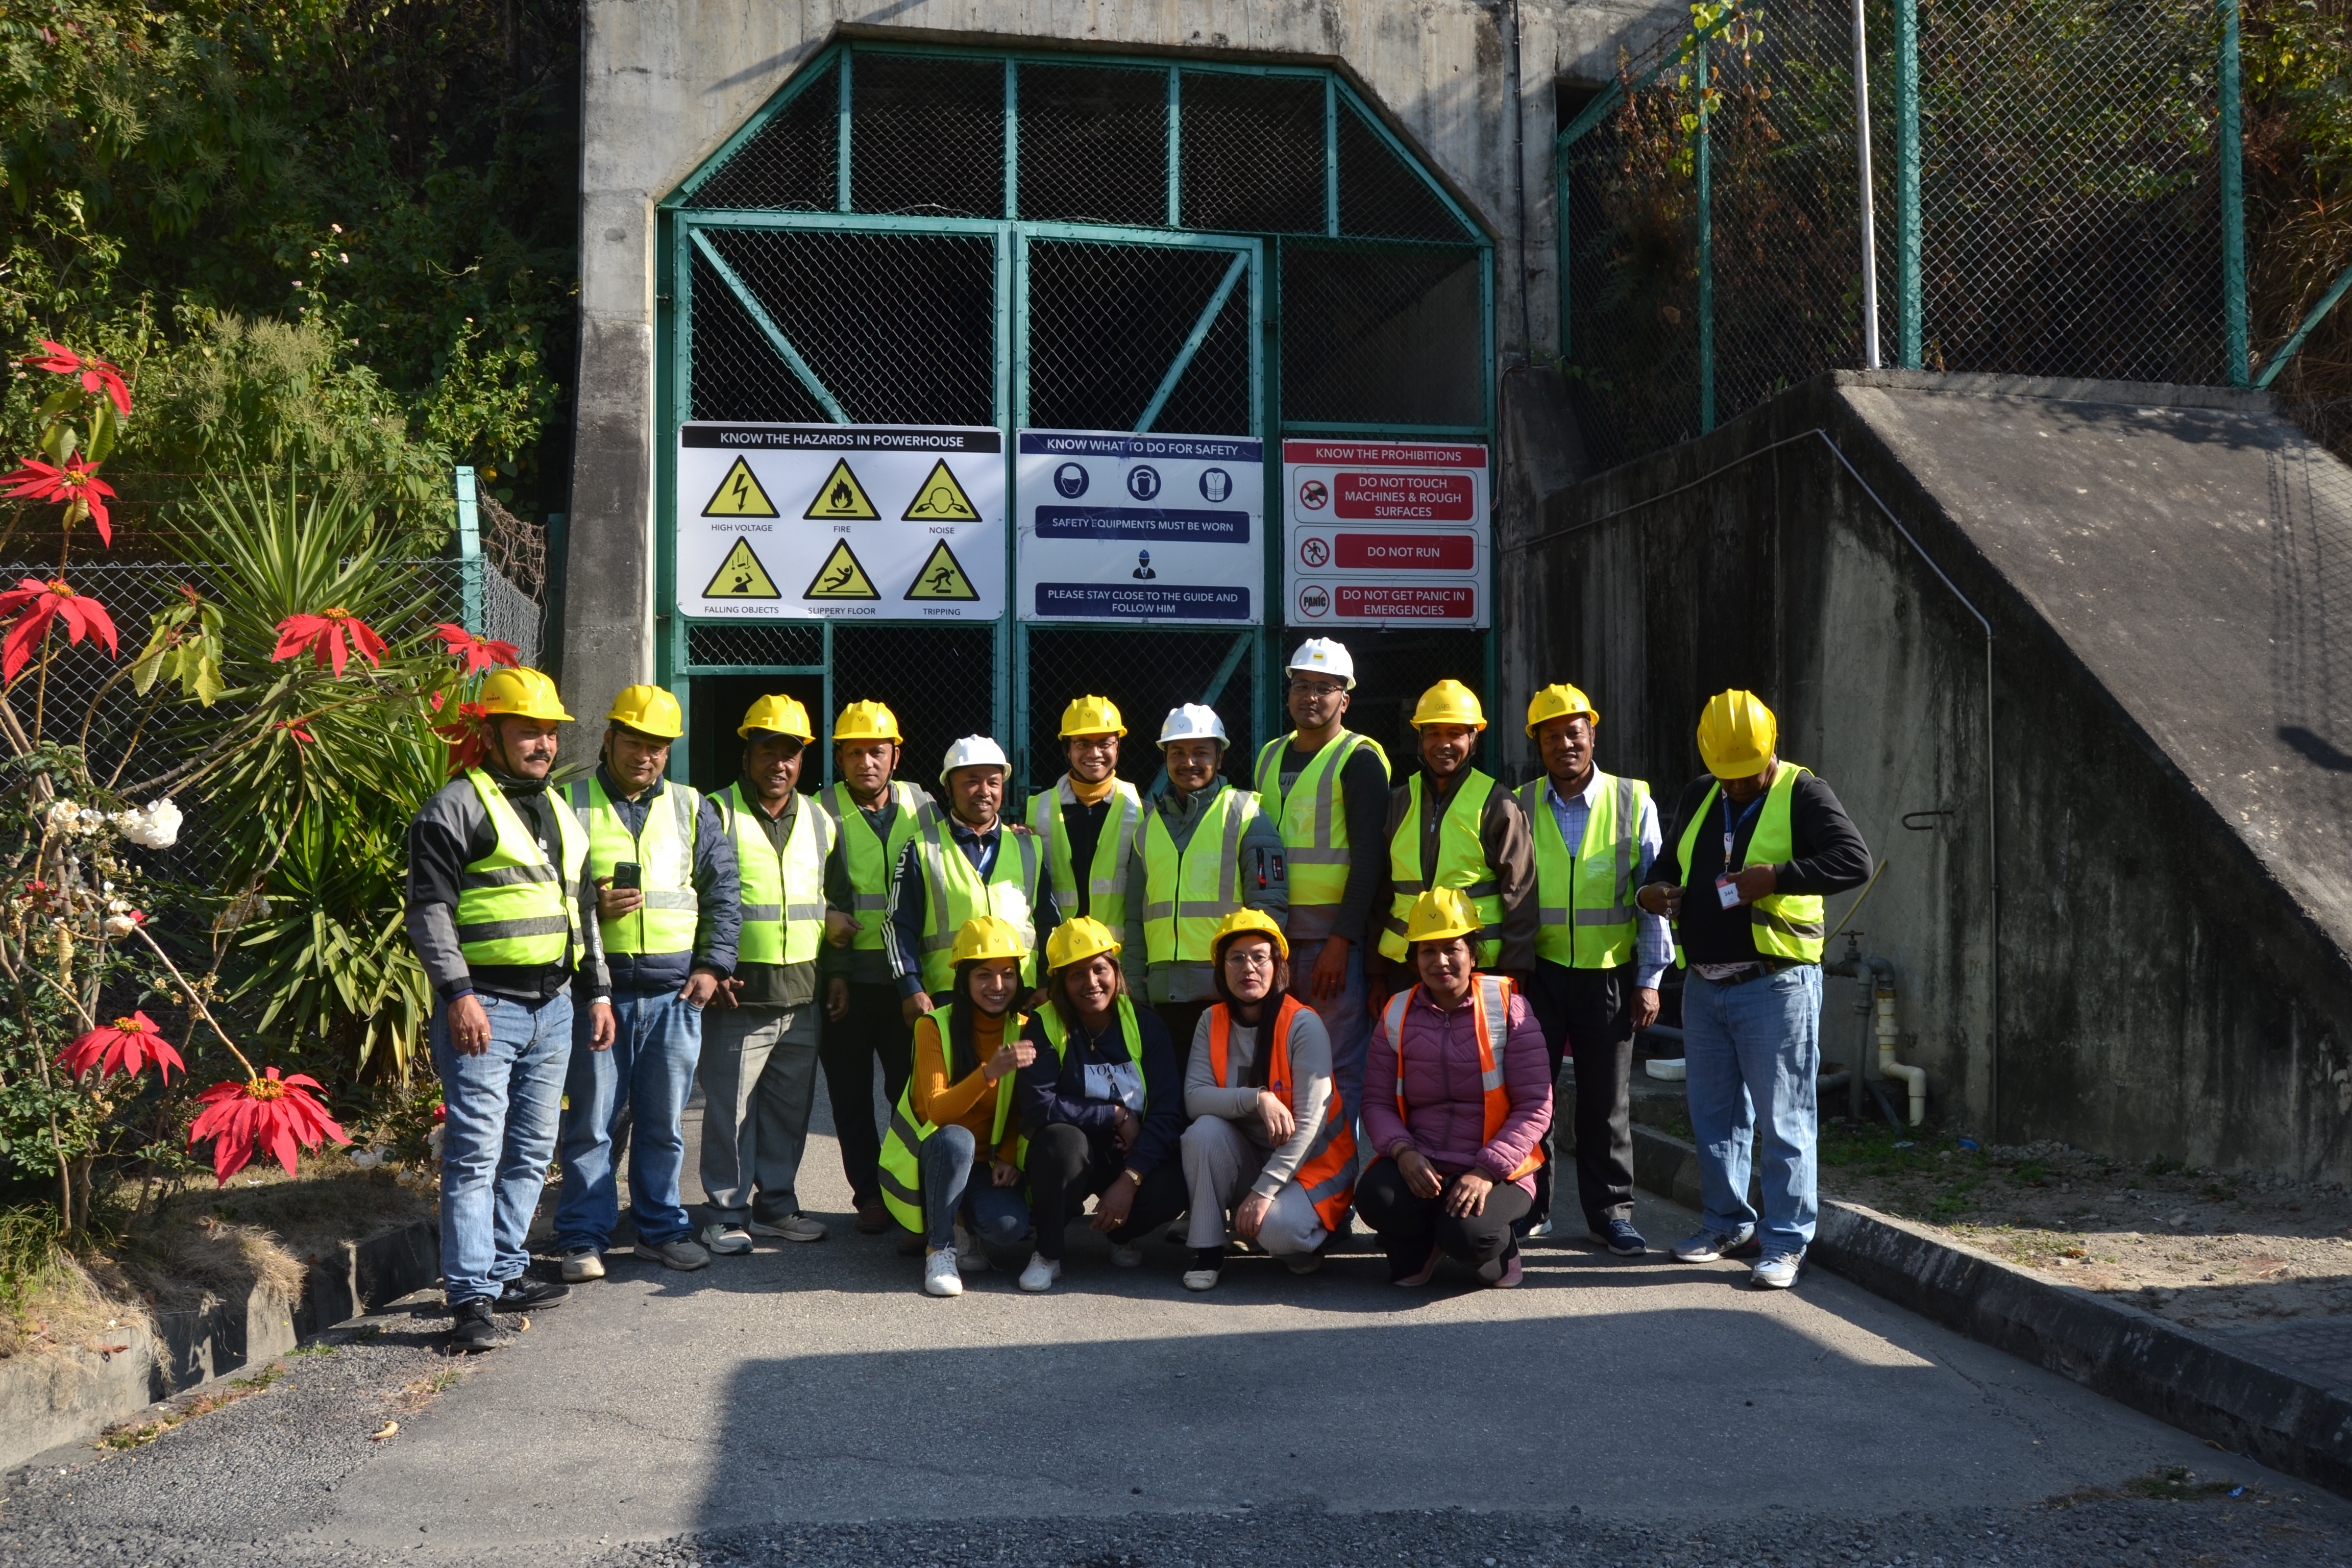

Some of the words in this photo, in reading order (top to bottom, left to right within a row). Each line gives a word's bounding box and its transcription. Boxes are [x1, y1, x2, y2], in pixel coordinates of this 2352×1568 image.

[721, 433, 763, 443] KNOW
[766, 434, 790, 444] THE
[794, 434, 853, 445] HAZARDS
[857, 435, 869, 445] IN
[874, 435, 964, 447] POWERHOUSE
[1048, 439, 1087, 449] KNOW
[1090, 440, 1125, 451] WHAT
[1130, 442, 1143, 451] TO
[1147, 443, 1165, 452] DO
[1169, 444, 1192, 453] FOR
[1196, 445, 1238, 455] SAFETY
[1316, 448, 1354, 458] KNOW
[1357, 449, 1378, 458] THE
[1382, 450, 1461, 461] PROHIBITIONS
[1360, 477, 1377, 486] DO
[1381, 478, 1405, 487] NOT
[1407, 478, 1447, 488] TOUCH
[1345, 492, 1405, 502] MACHINES
[1409, 493, 1416, 502] &
[1420, 493, 1461, 502] ROUGH
[1375, 506, 1431, 517] SURFACES
[1053, 519, 1089, 527] SAFETY
[1092, 519, 1156, 530] EQUIPMENTS
[1202, 523, 1233, 531] WORN
[1368, 547, 1384, 556] DO
[1389, 548, 1413, 556] NOT
[1416, 548, 1439, 557] RUN
[1048, 590, 1084, 598] PLEASE
[1113, 592, 1143, 600] CLOSE
[1146, 592, 1160, 600] TO
[1184, 593, 1213, 601] GUIDE
[1343, 591, 1361, 599] DO
[1365, 591, 1388, 600] NOT
[1392, 591, 1413, 600] GET
[1417, 591, 1450, 600] PANIC
[1454, 592, 1464, 600] IN
[1304, 597, 1326, 606] PANIC
[808, 607, 845, 615] SLIPPERY
[1113, 604, 1154, 612] FOLLOW
[1364, 605, 1444, 615] EMERGENCIES
[1089, 1063, 1131, 1075] VOGUE
